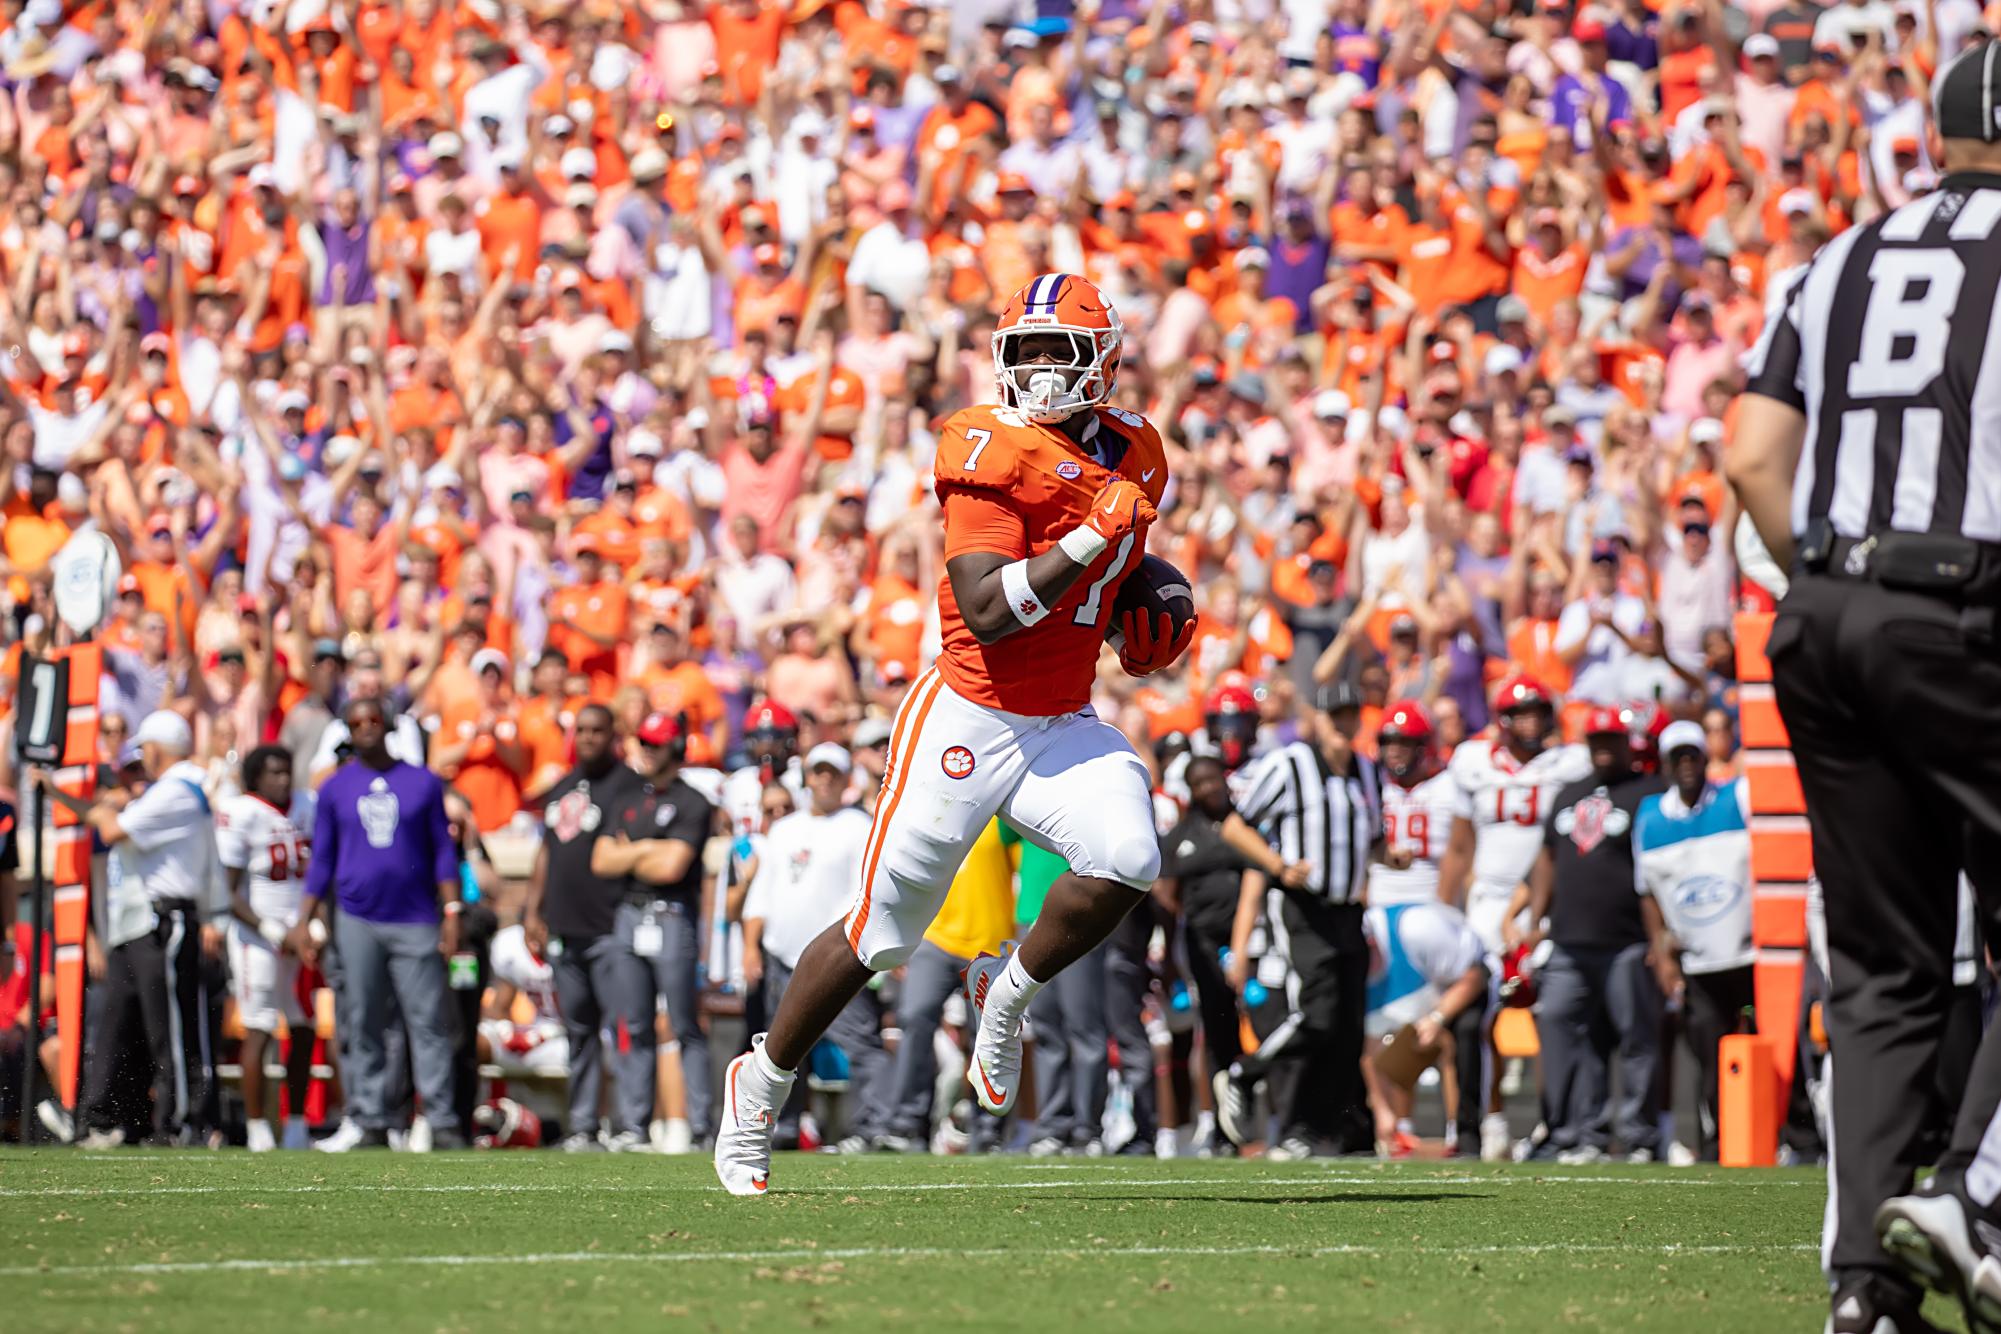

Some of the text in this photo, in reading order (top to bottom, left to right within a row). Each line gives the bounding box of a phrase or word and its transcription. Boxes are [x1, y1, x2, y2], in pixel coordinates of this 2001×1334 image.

[1847, 247, 1966, 399] B
[963, 427, 992, 473] 7
[29, 663, 56, 746] 1
[1496, 785, 1539, 827] 13
[974, 968, 990, 1010] NIKE
